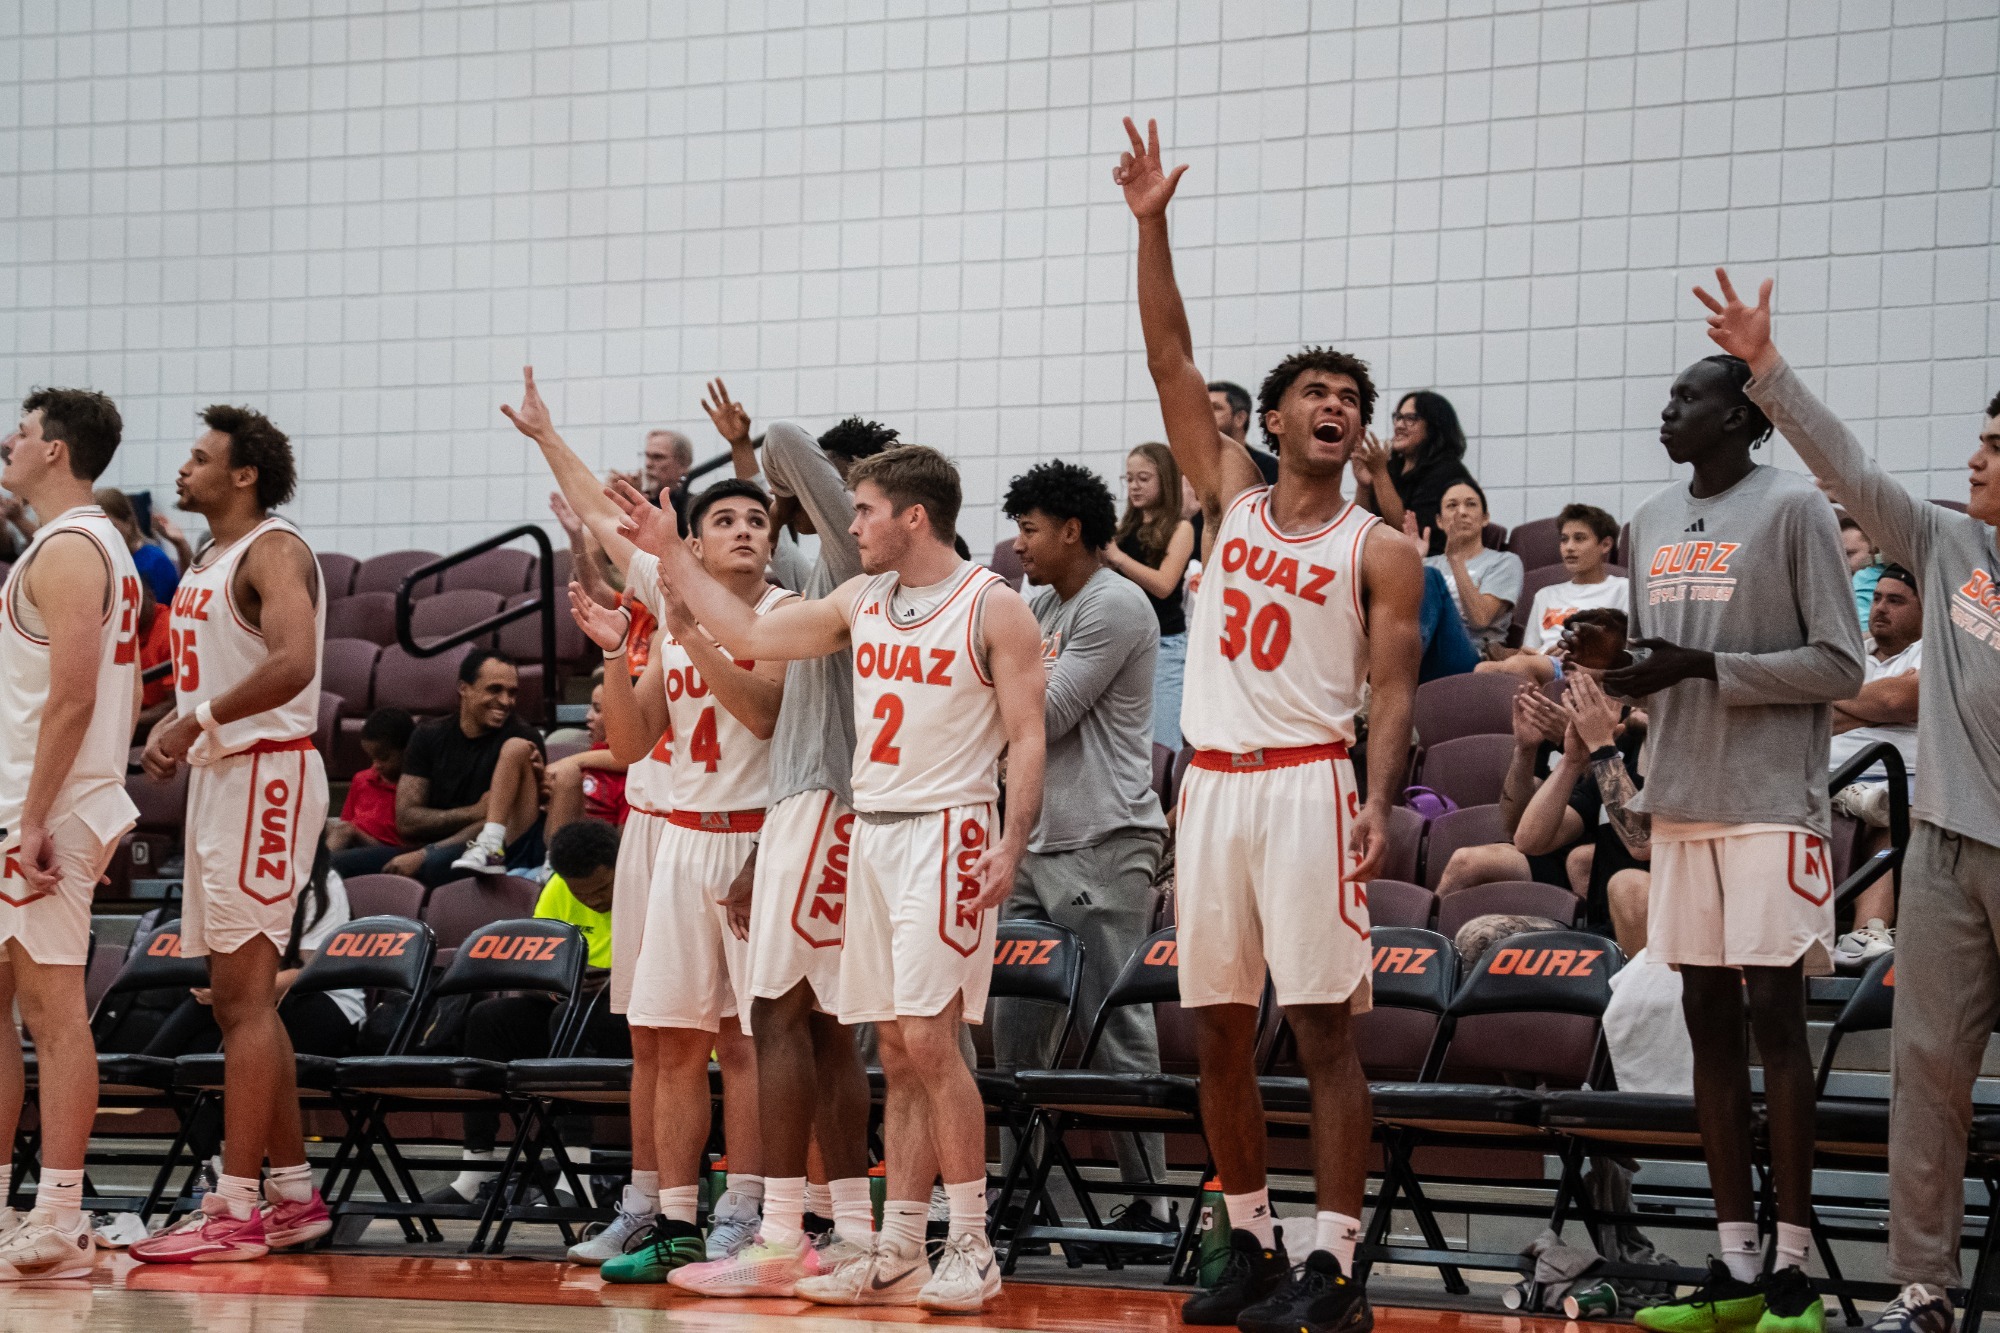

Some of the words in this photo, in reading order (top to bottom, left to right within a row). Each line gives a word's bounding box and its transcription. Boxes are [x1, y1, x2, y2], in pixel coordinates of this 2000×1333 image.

[1222, 537, 1337, 606] OUAZ
[1649, 541, 1741, 577] OUAZ
[172, 587, 213, 621] UAZ
[1220, 587, 1292, 672] 30
[856, 642, 956, 687] OUAZ
[690, 706, 721, 773] 4
[869, 692, 904, 766] 2
[255, 779, 289, 881] OUAZ
[326, 933, 416, 957] OUAZ
[468, 935, 567, 961] OUAZ
[1488, 949, 1604, 976] OUAZ
